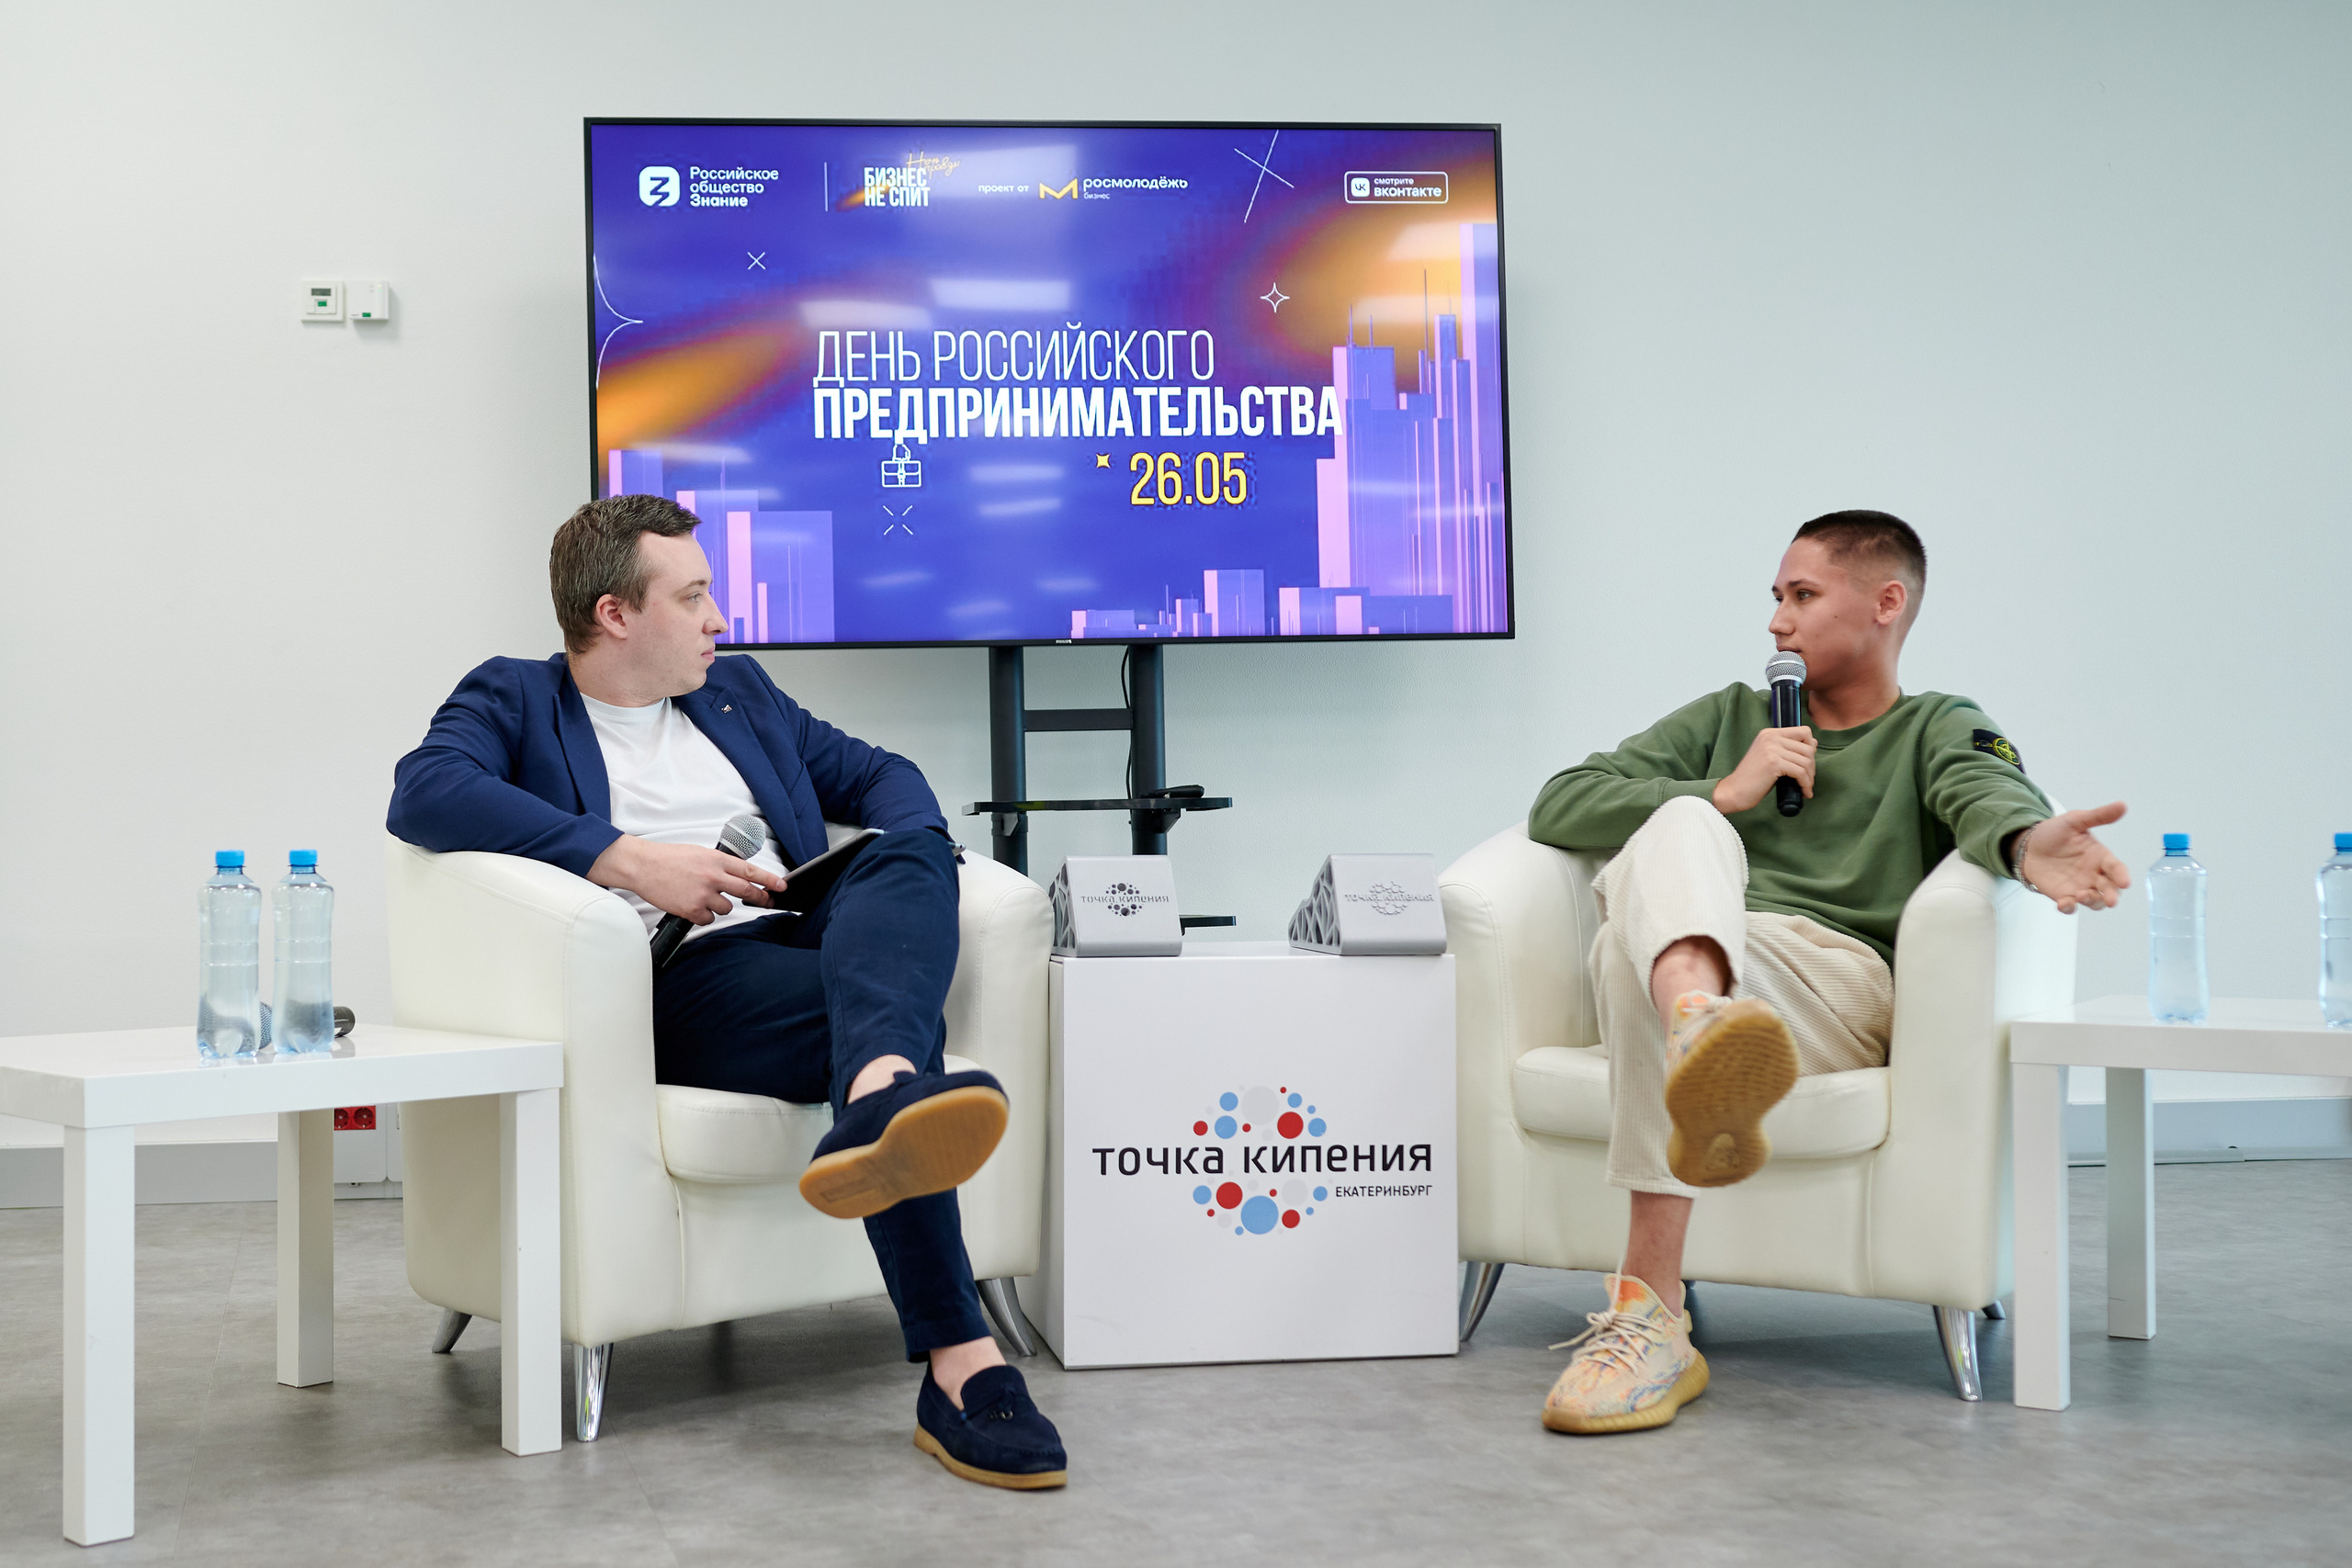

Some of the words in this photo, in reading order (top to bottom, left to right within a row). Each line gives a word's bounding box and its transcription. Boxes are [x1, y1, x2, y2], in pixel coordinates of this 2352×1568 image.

[689, 166, 779, 180] Российское
[864, 167, 927, 187] БИЗНЕС
[1374, 177, 1415, 186] смотрите
[689, 180, 764, 195] общество
[978, 185, 1013, 194] проект
[1017, 185, 1029, 193] от
[1083, 175, 1188, 192] росмолодёжь
[689, 194, 749, 207] Знание
[864, 186, 887, 207] НЕ
[888, 186, 931, 207] СПИТ
[812, 330, 922, 388] ДЕНЬ
[933, 321, 1216, 381] РОССИЙСКОГО
[812, 385, 1344, 445] ПРЕДПРИНИМАТЕЛЬСТВА
[1128, 451, 1249, 506] 26.05
[1091, 1146, 1225, 1176] точка
[1243, 1144, 1433, 1174] кипения
[1335, 1185, 1433, 1198] ЕКАТЕРИНБУРГ
